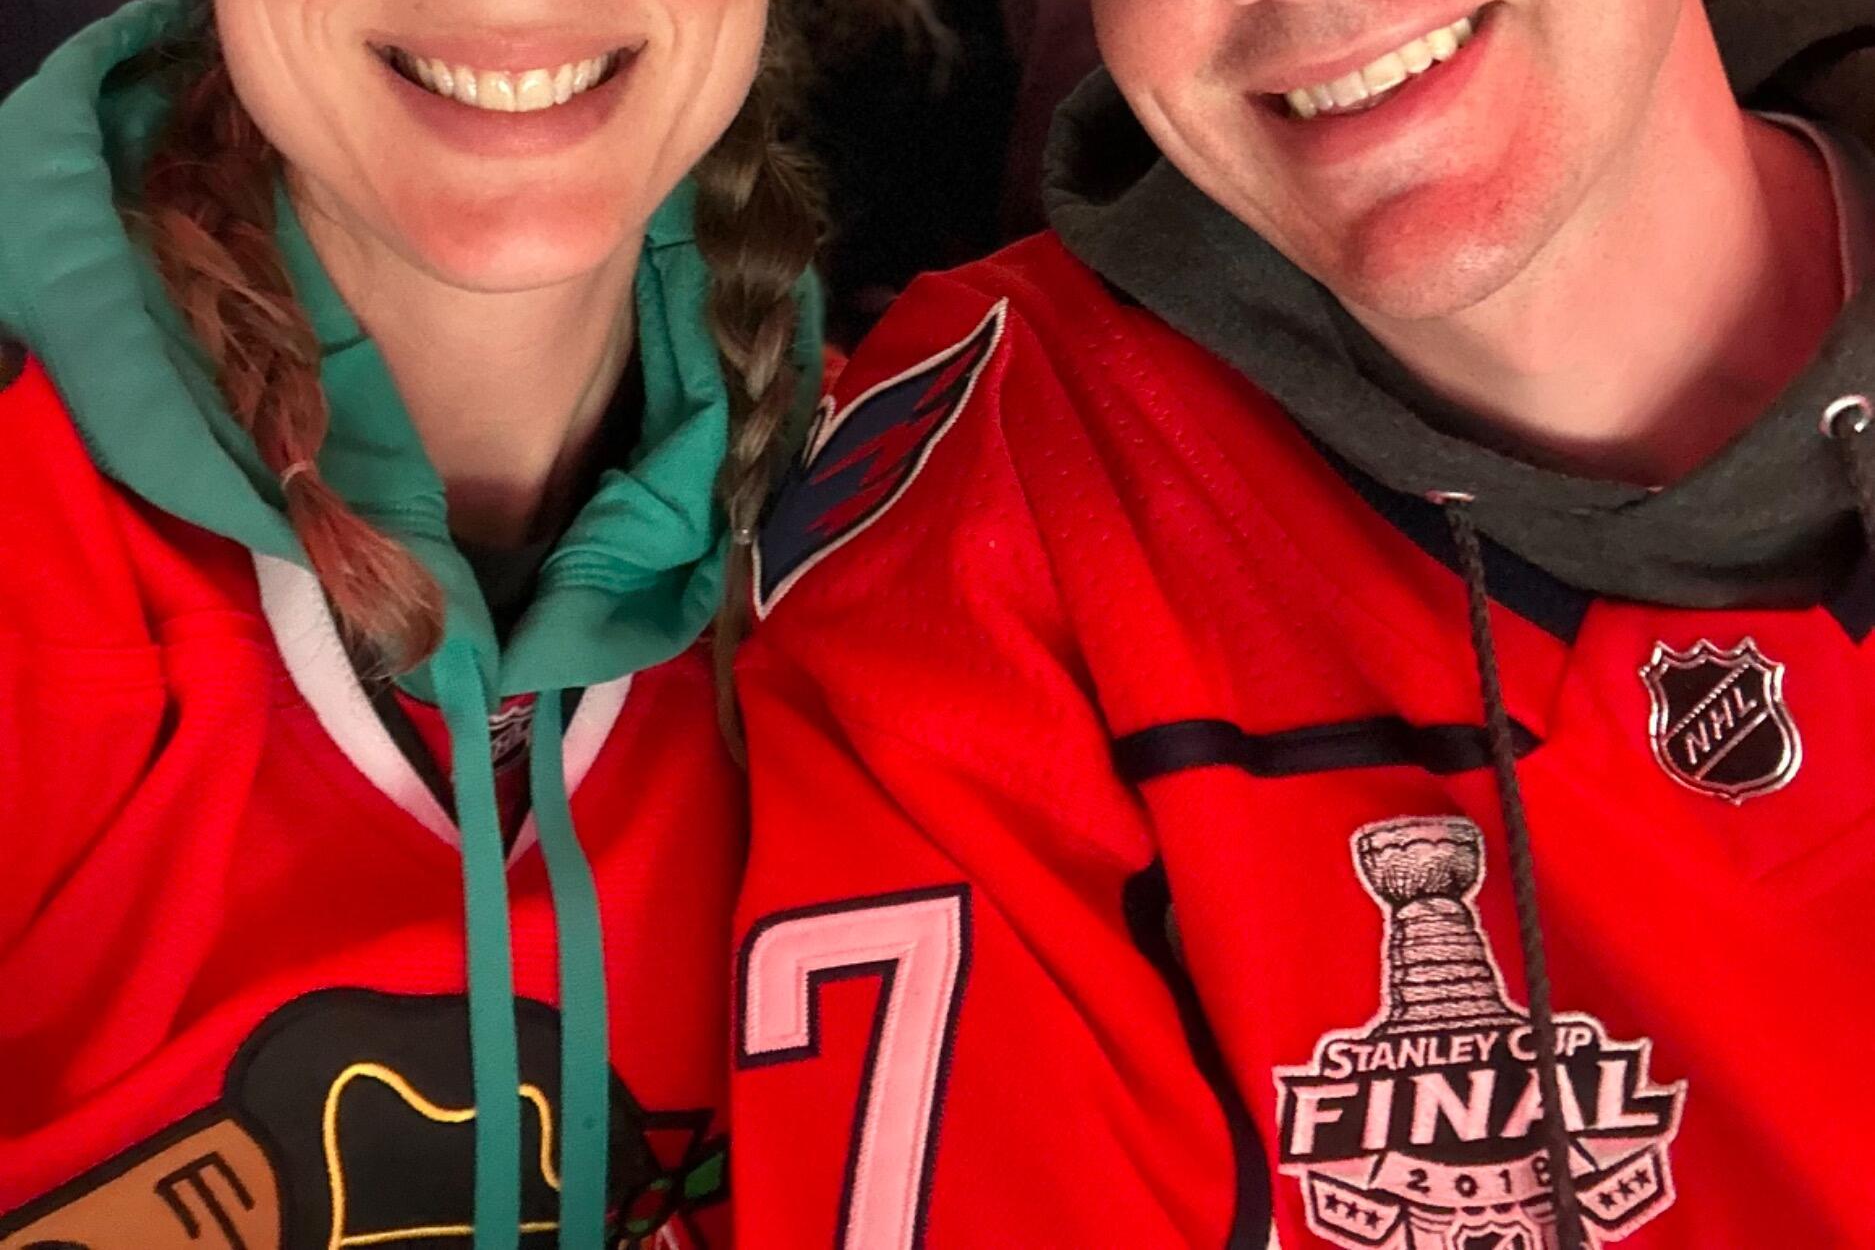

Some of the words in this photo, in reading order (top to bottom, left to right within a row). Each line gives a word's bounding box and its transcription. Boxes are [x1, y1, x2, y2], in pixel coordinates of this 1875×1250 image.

[1685, 686, 1758, 765] NHL
[736, 883, 972, 1250] 7
[1324, 1031, 1499, 1080] STANLEY
[1290, 1059, 1660, 1155] FINAL
